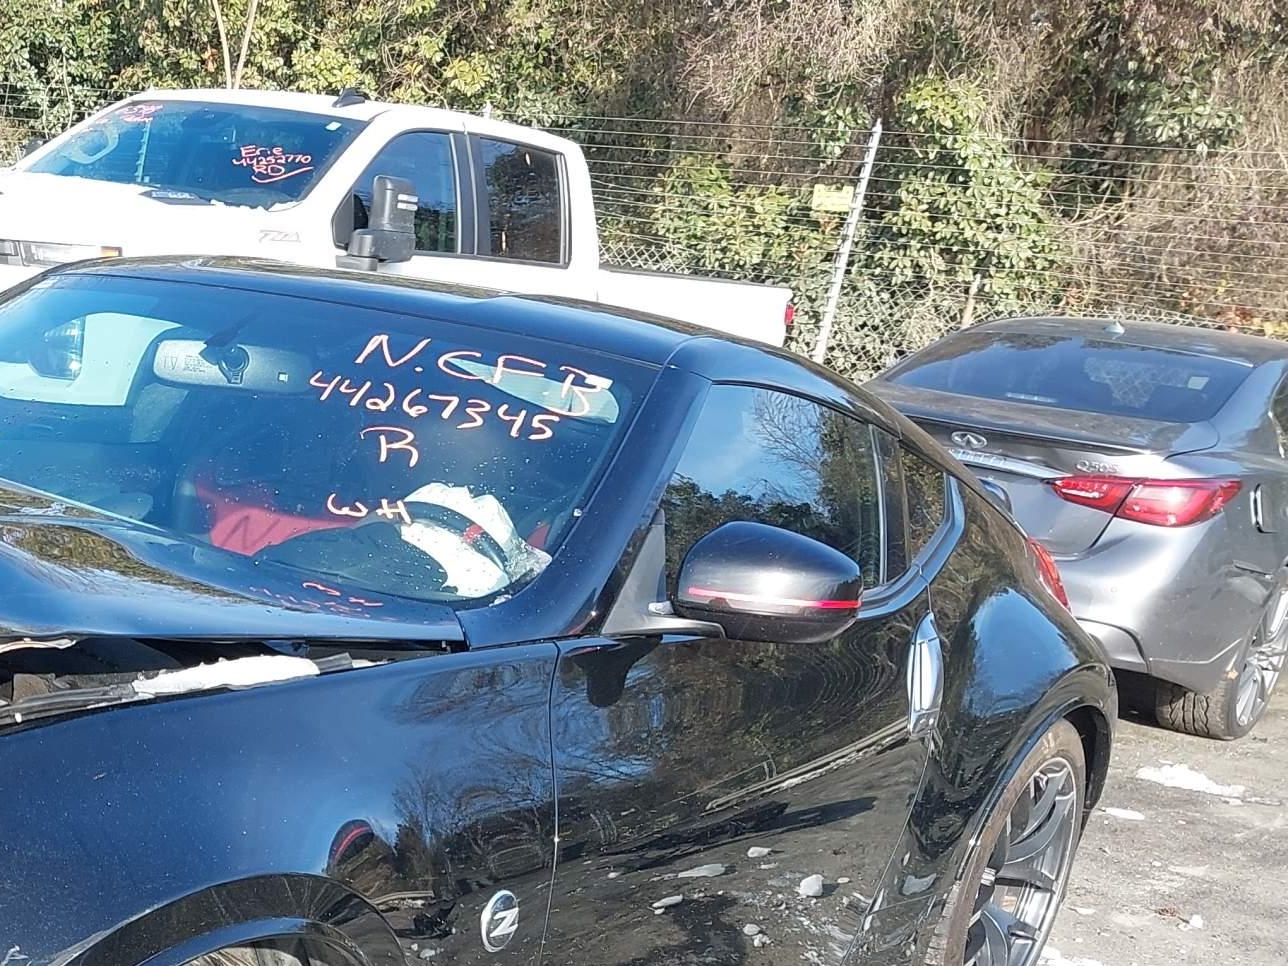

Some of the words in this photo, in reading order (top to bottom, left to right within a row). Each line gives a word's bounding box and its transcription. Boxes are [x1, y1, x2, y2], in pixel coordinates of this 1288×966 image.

[240, 145, 283, 158] Erie
[232, 155, 312, 167] 44252770
[253, 164, 285, 176] RD
[309, 370, 560, 440] 44267345
[360, 426, 419, 468] R
